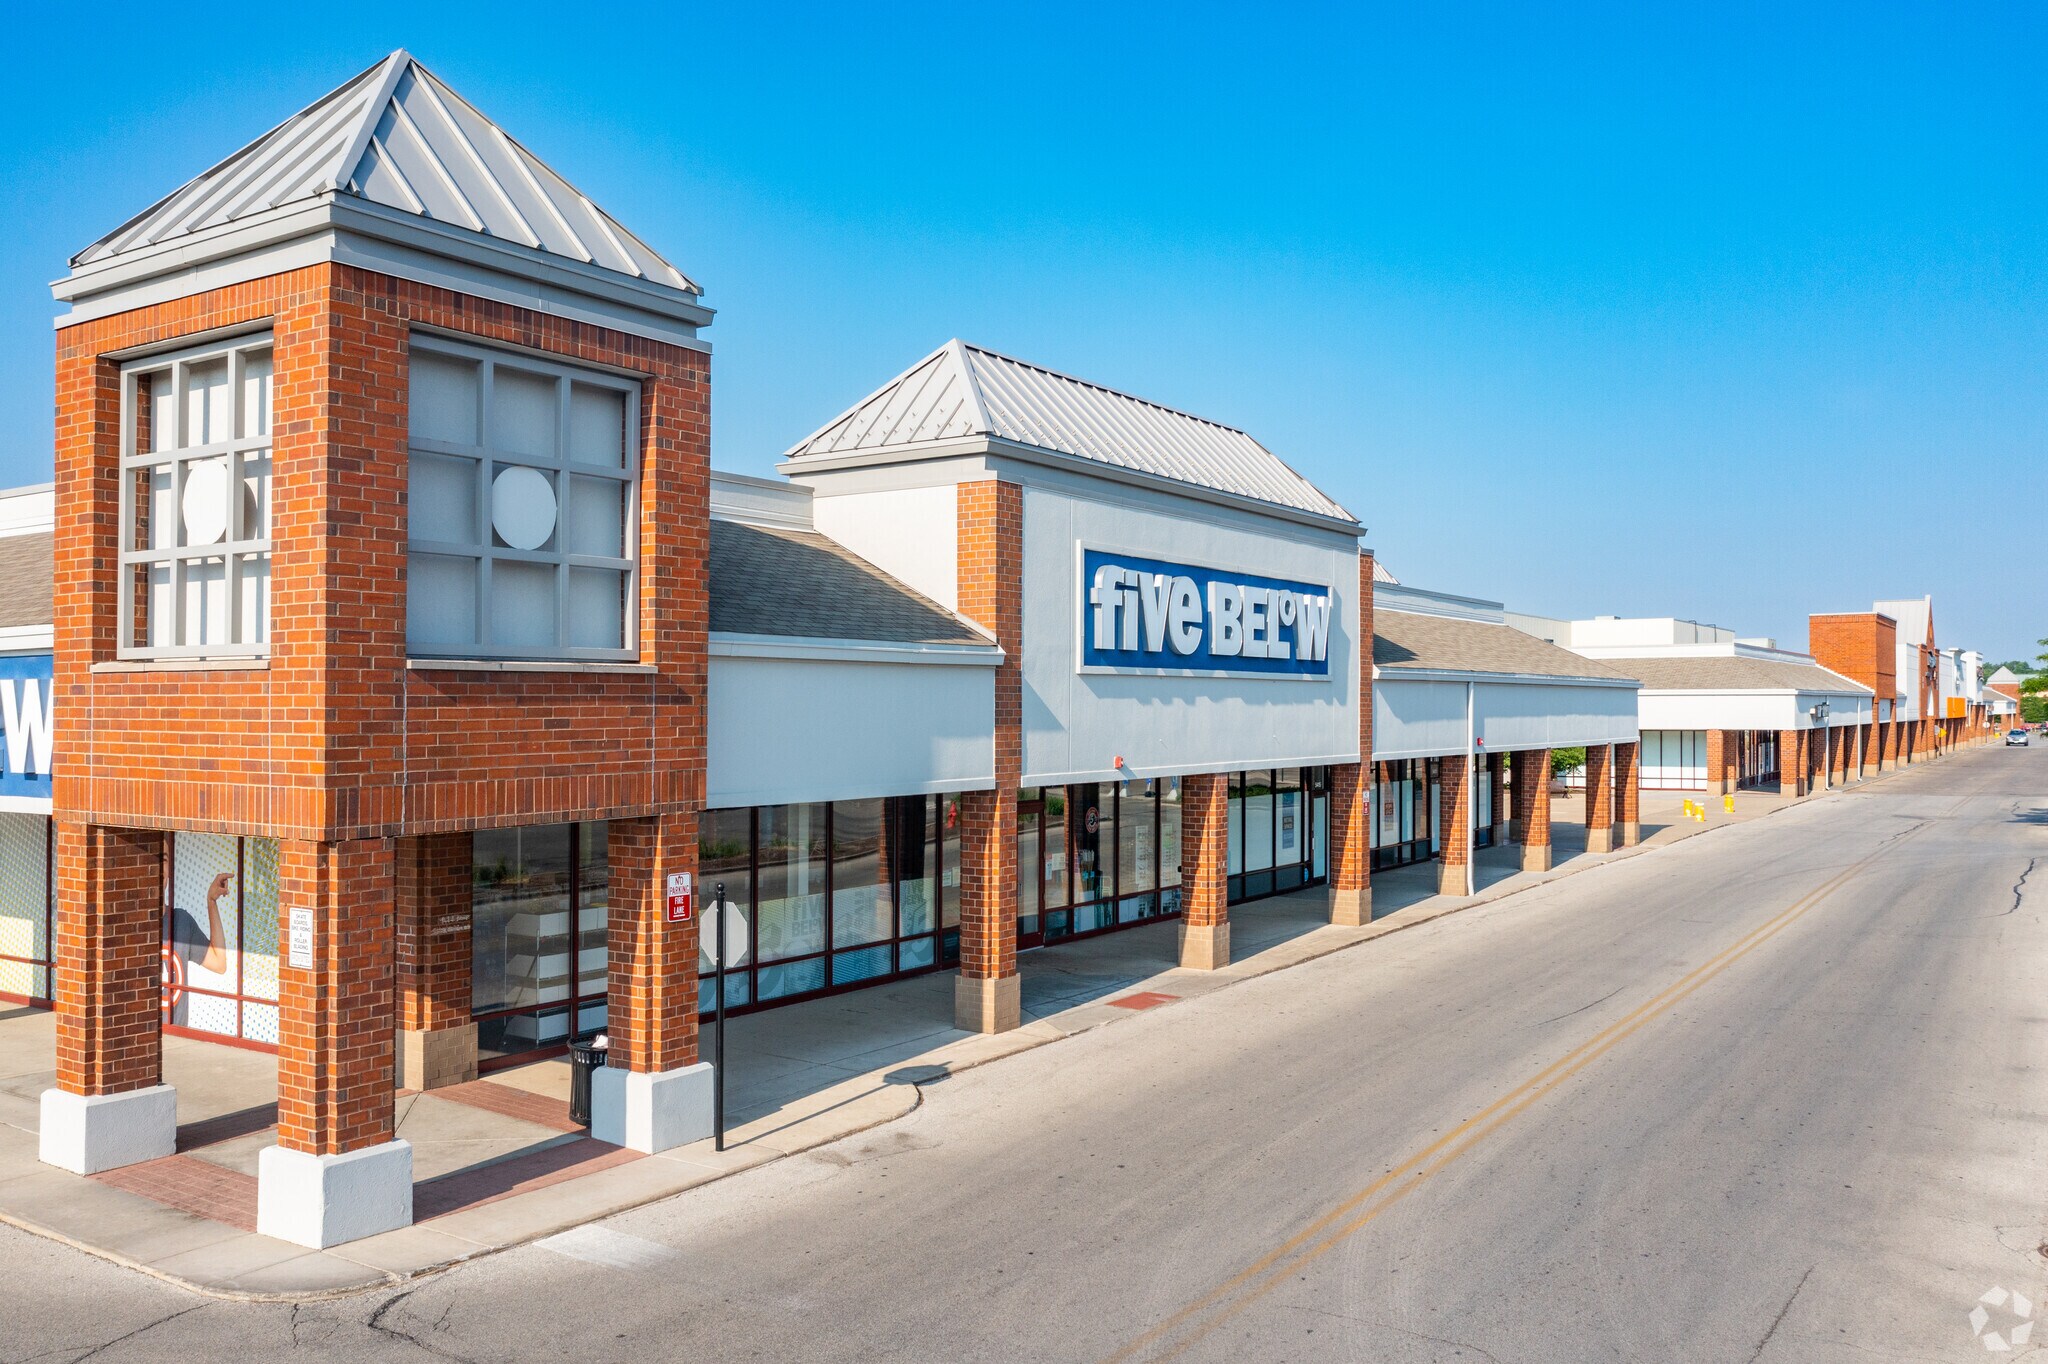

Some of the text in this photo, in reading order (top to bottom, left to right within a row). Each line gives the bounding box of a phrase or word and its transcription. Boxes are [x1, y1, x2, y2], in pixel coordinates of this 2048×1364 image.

[675, 876, 683, 885] NO
[670, 885, 689, 895] PARKING
[674, 896, 684, 905] FIRE
[673, 905, 685, 915] LANE
